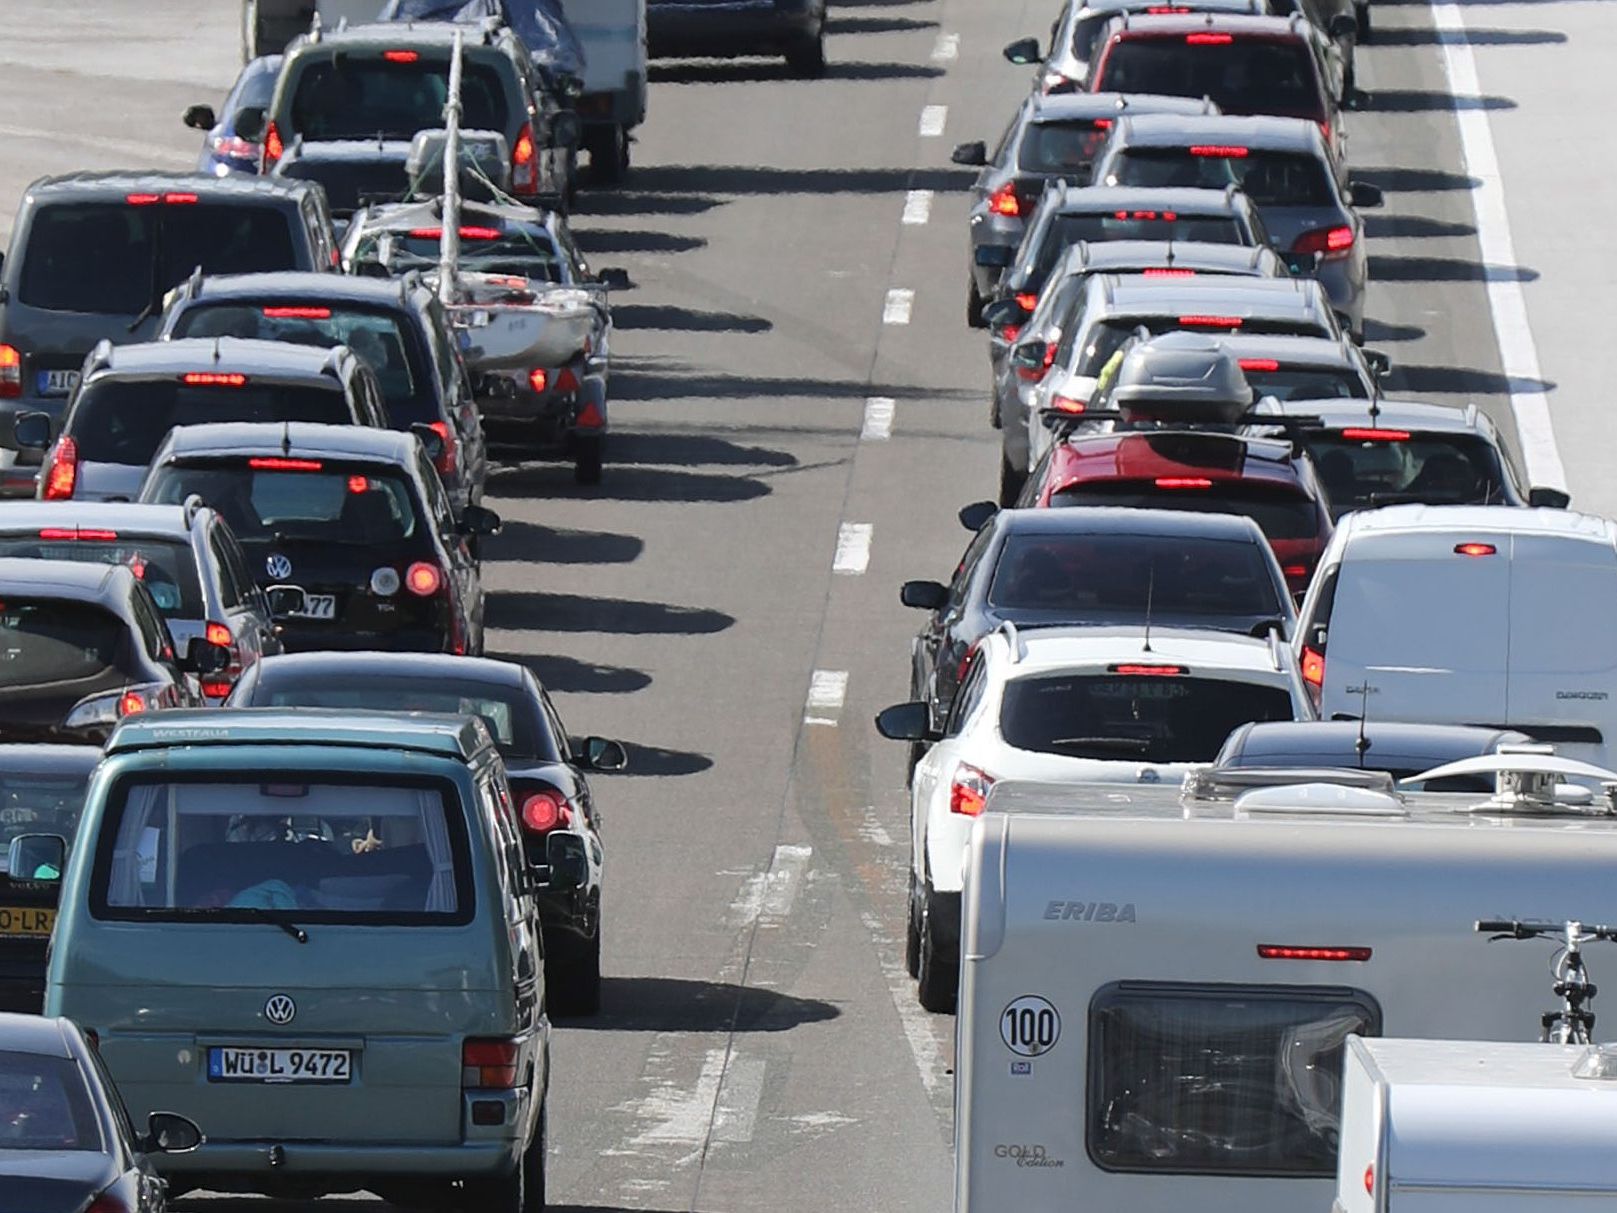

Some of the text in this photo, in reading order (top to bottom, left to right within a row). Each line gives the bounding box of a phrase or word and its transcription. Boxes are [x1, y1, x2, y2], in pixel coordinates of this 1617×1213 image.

[152, 729, 229, 738] WESTFALIA
[1043, 900, 1137, 923] ERIBA
[265, 994, 295, 1025] VW
[1005, 1008, 1054, 1046] 100
[224, 1051, 348, 1077] WÜ L 9472
[994, 1144, 1046, 1159] GOLD
